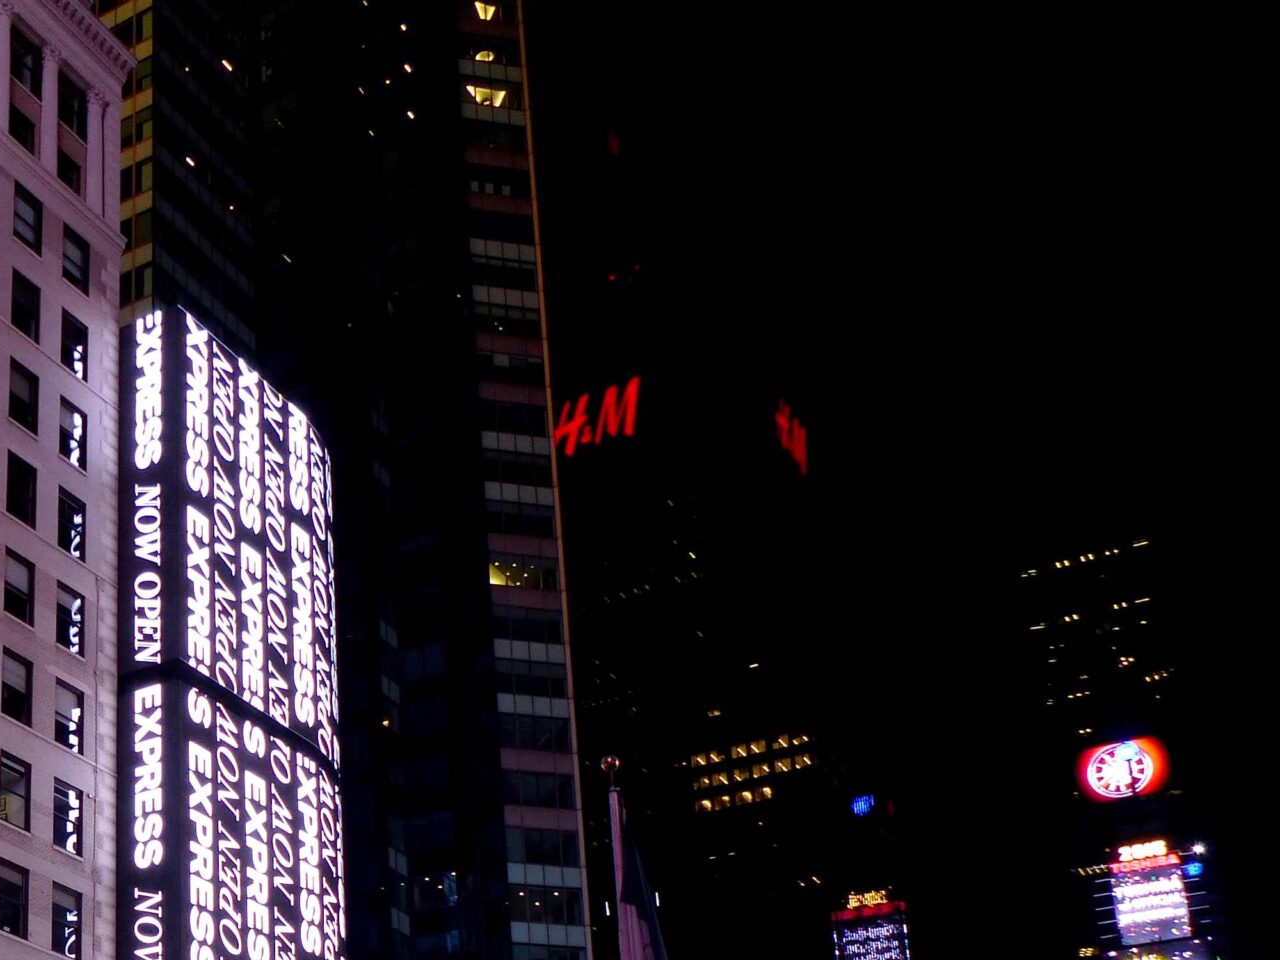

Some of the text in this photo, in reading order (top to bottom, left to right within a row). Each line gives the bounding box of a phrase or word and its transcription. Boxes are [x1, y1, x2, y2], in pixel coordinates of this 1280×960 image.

[133, 482, 162, 567] NOW
[133, 571, 162, 665] OPEN
[291, 521, 318, 728] EXPRESS
[133, 683, 163, 868] EXPRESS
